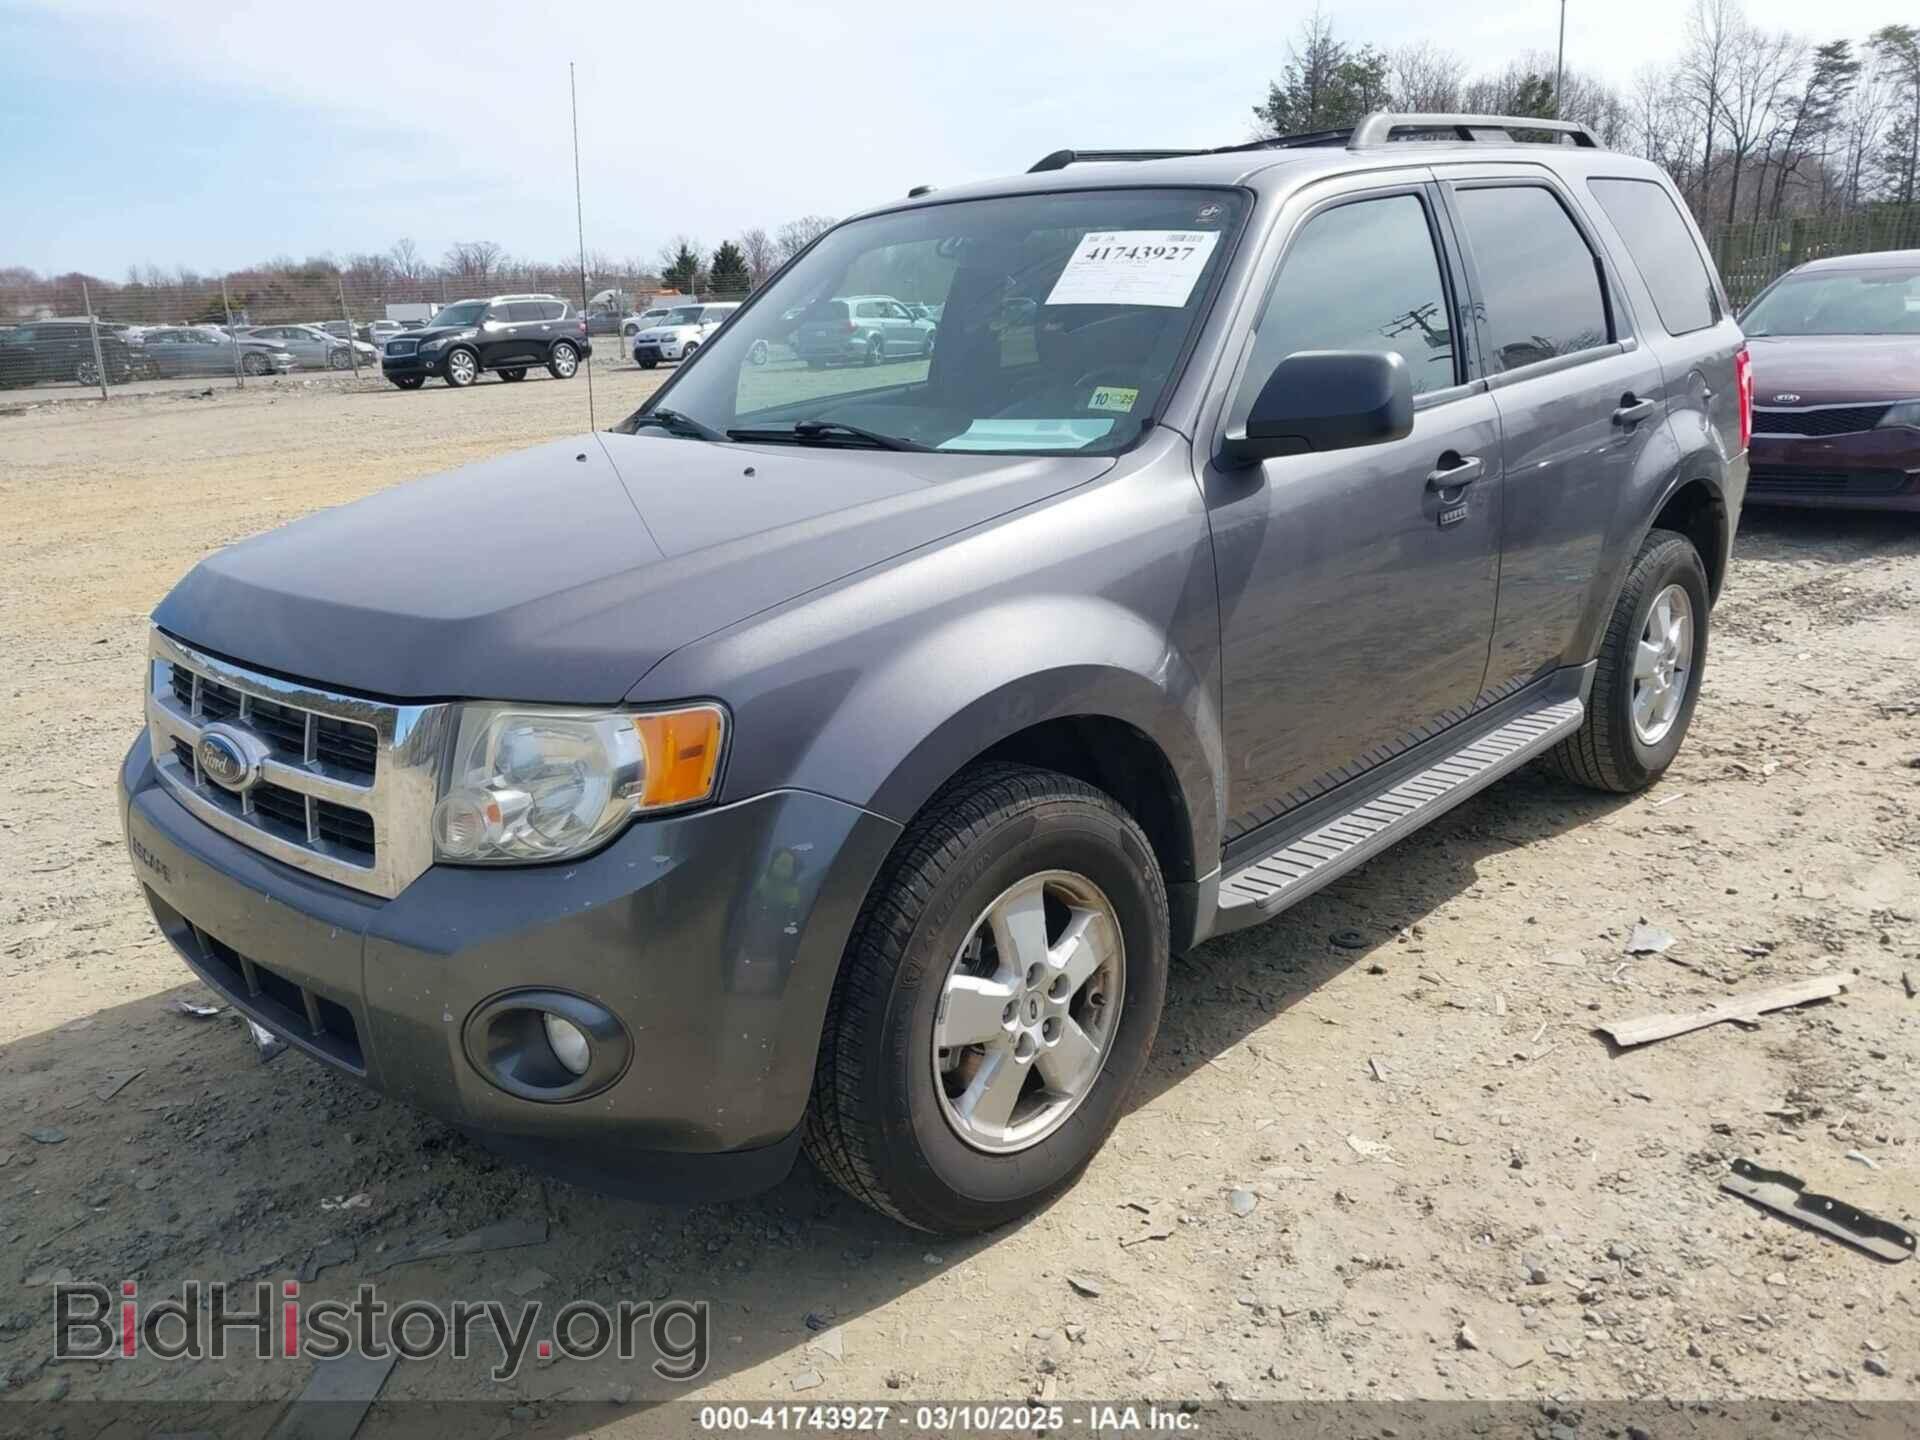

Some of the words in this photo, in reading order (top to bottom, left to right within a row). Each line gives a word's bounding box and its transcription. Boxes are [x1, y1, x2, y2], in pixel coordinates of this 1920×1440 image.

[1086, 246, 1195, 261] 41743927
[1094, 392, 1109, 406] 10
[202, 742, 229, 774] Ford
